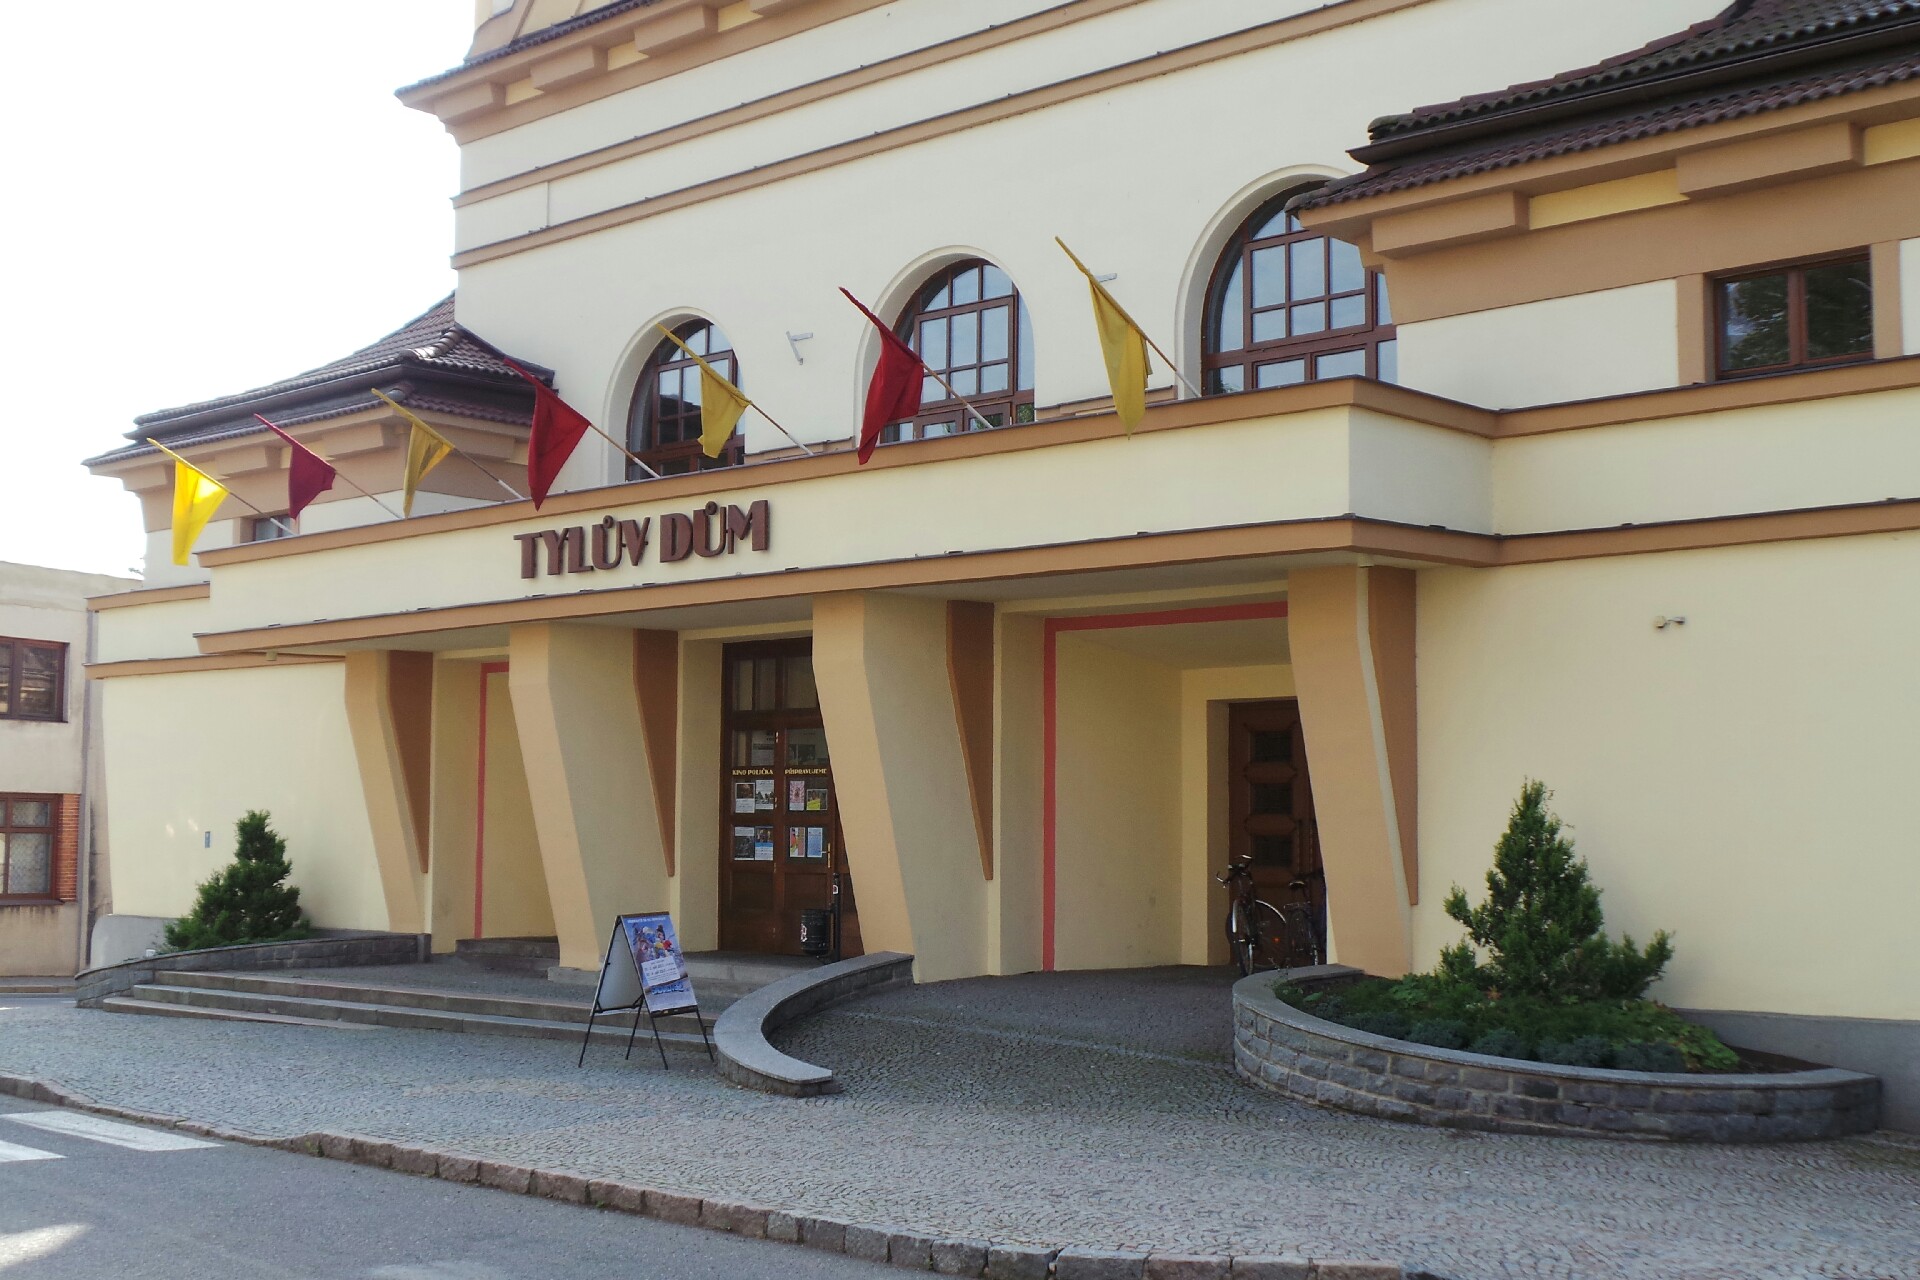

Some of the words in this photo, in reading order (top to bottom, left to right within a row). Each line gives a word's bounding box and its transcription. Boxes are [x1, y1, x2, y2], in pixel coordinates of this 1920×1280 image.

[513, 515, 650, 579] TYLŮV
[660, 499, 769, 564] DŮM
[747, 768, 774, 776] POLIČKA
